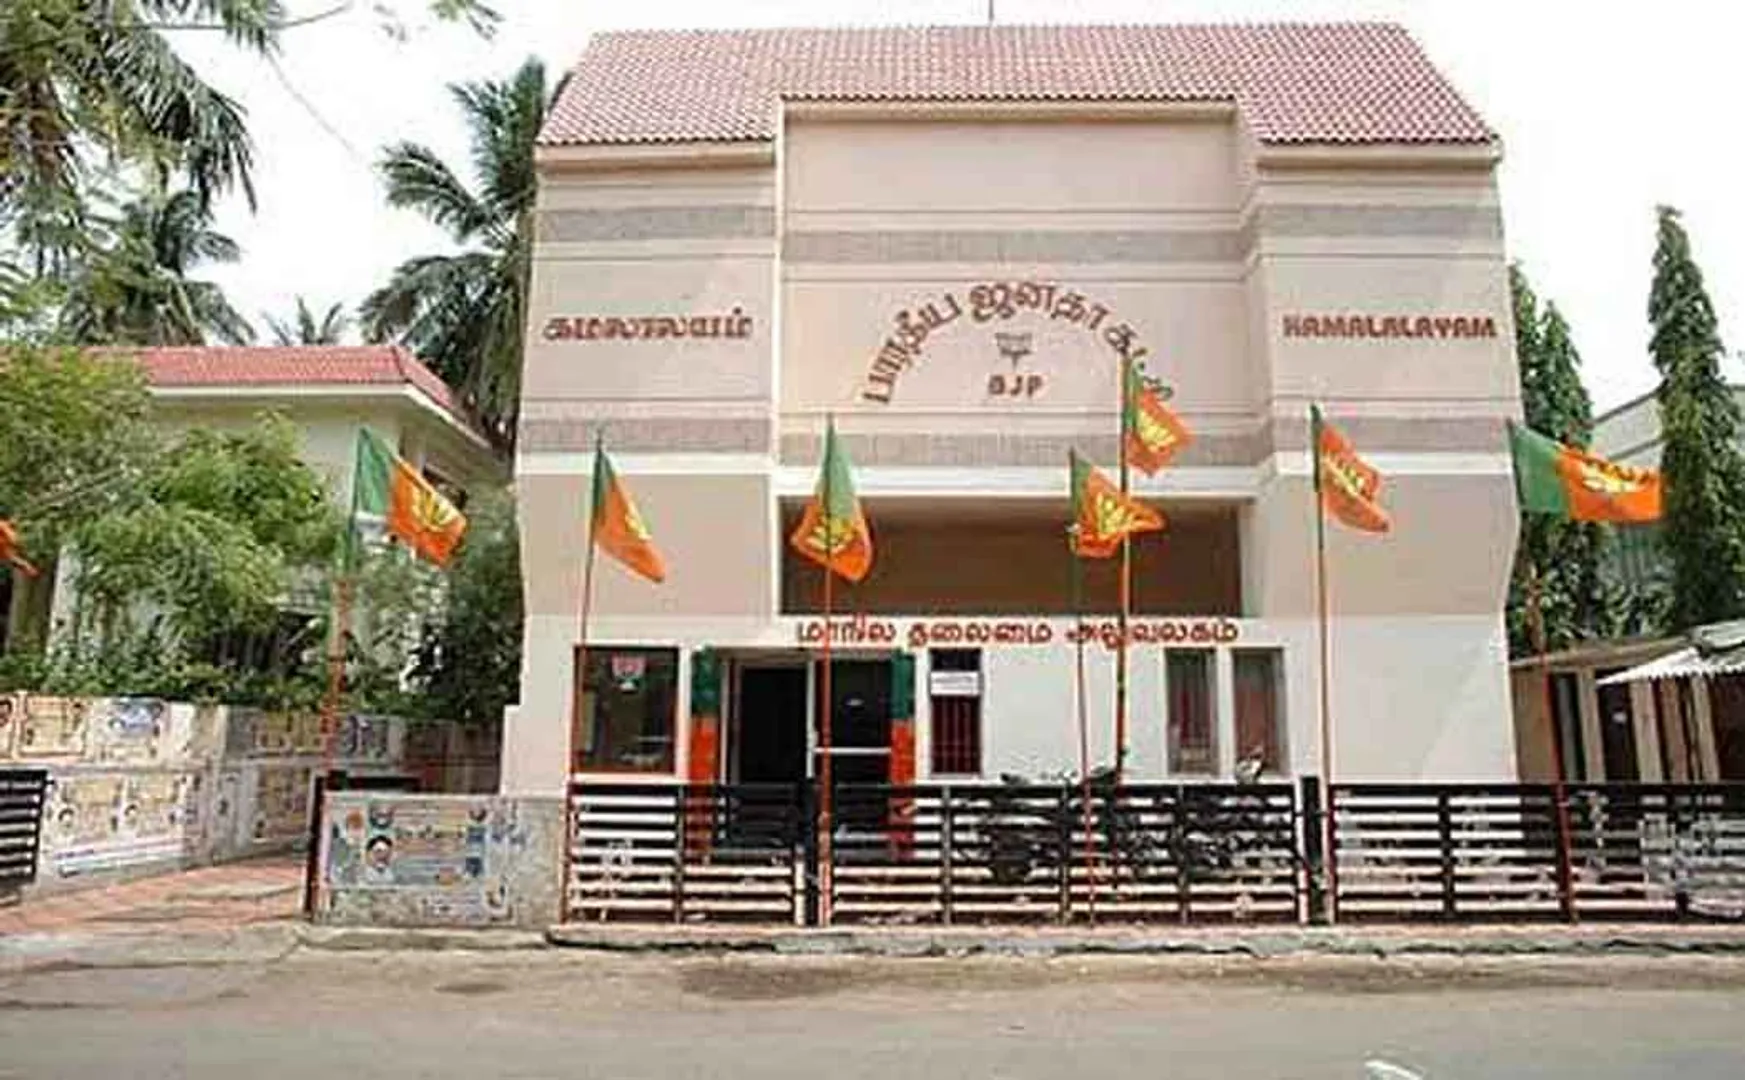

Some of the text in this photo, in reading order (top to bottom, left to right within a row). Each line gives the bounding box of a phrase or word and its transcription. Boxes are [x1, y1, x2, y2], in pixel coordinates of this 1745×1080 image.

[1282, 314, 1498, 339] KAMALALAYAM
[987, 374, 1042, 398] BJP
[907, 621, 1053, 647] தலைமை
